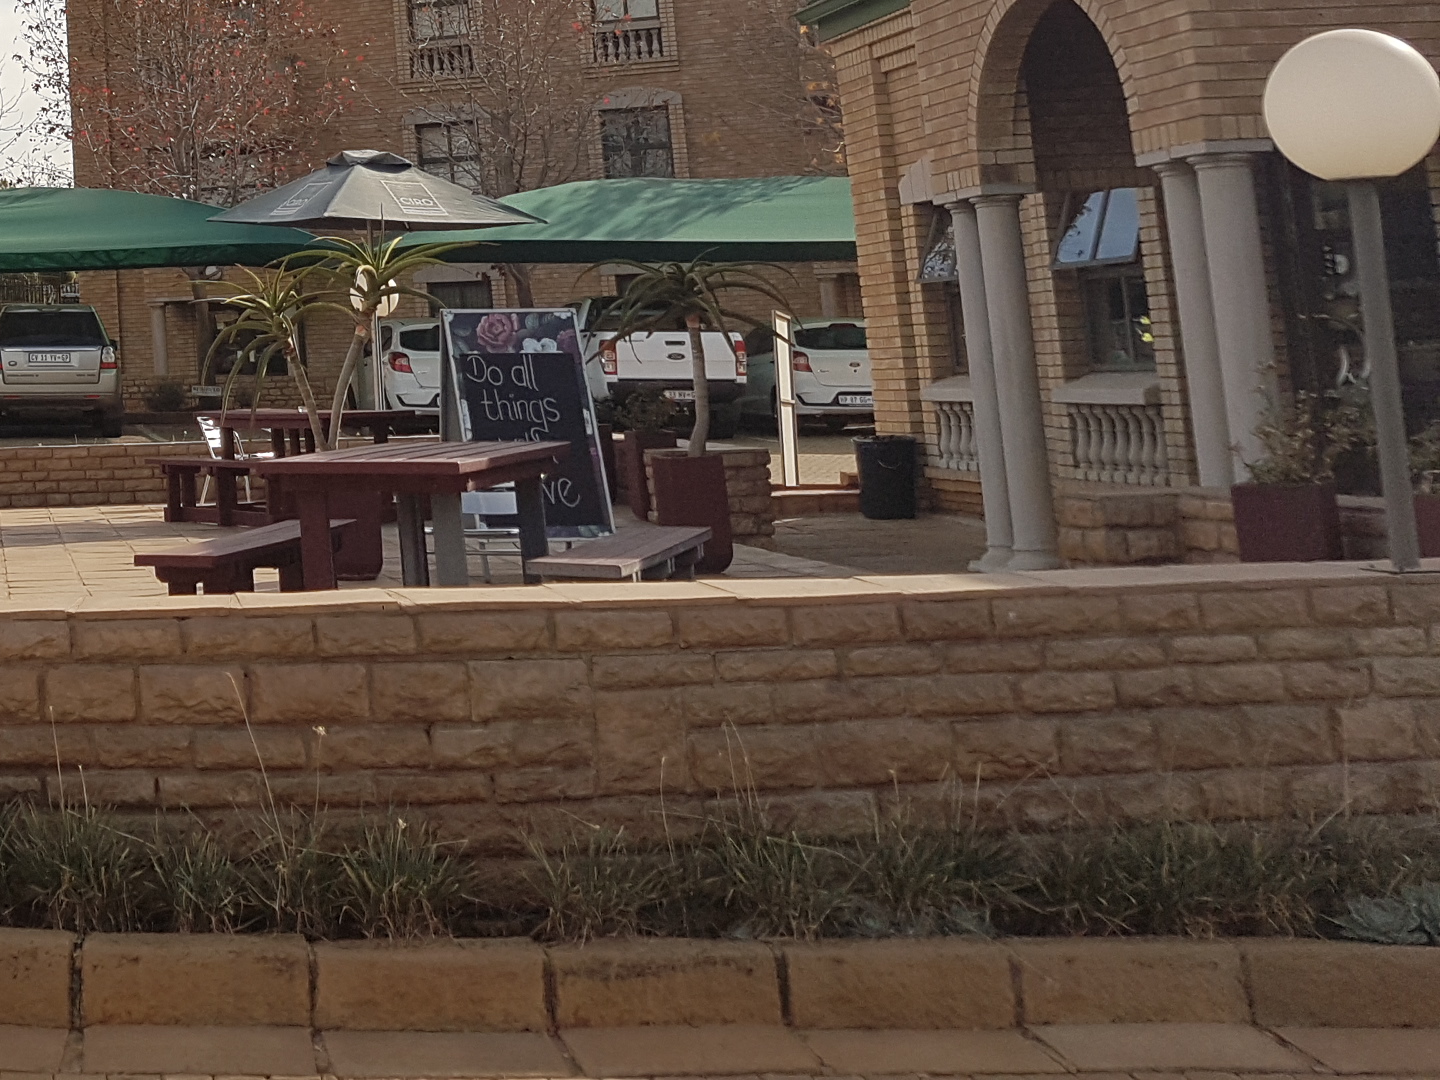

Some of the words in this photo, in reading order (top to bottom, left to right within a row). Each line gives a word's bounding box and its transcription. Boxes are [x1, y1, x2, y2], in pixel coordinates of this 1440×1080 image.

[466, 355, 503, 386] Do
[511, 354, 539, 391] all
[480, 389, 561, 434] things
[542, 478, 581, 508] ve
